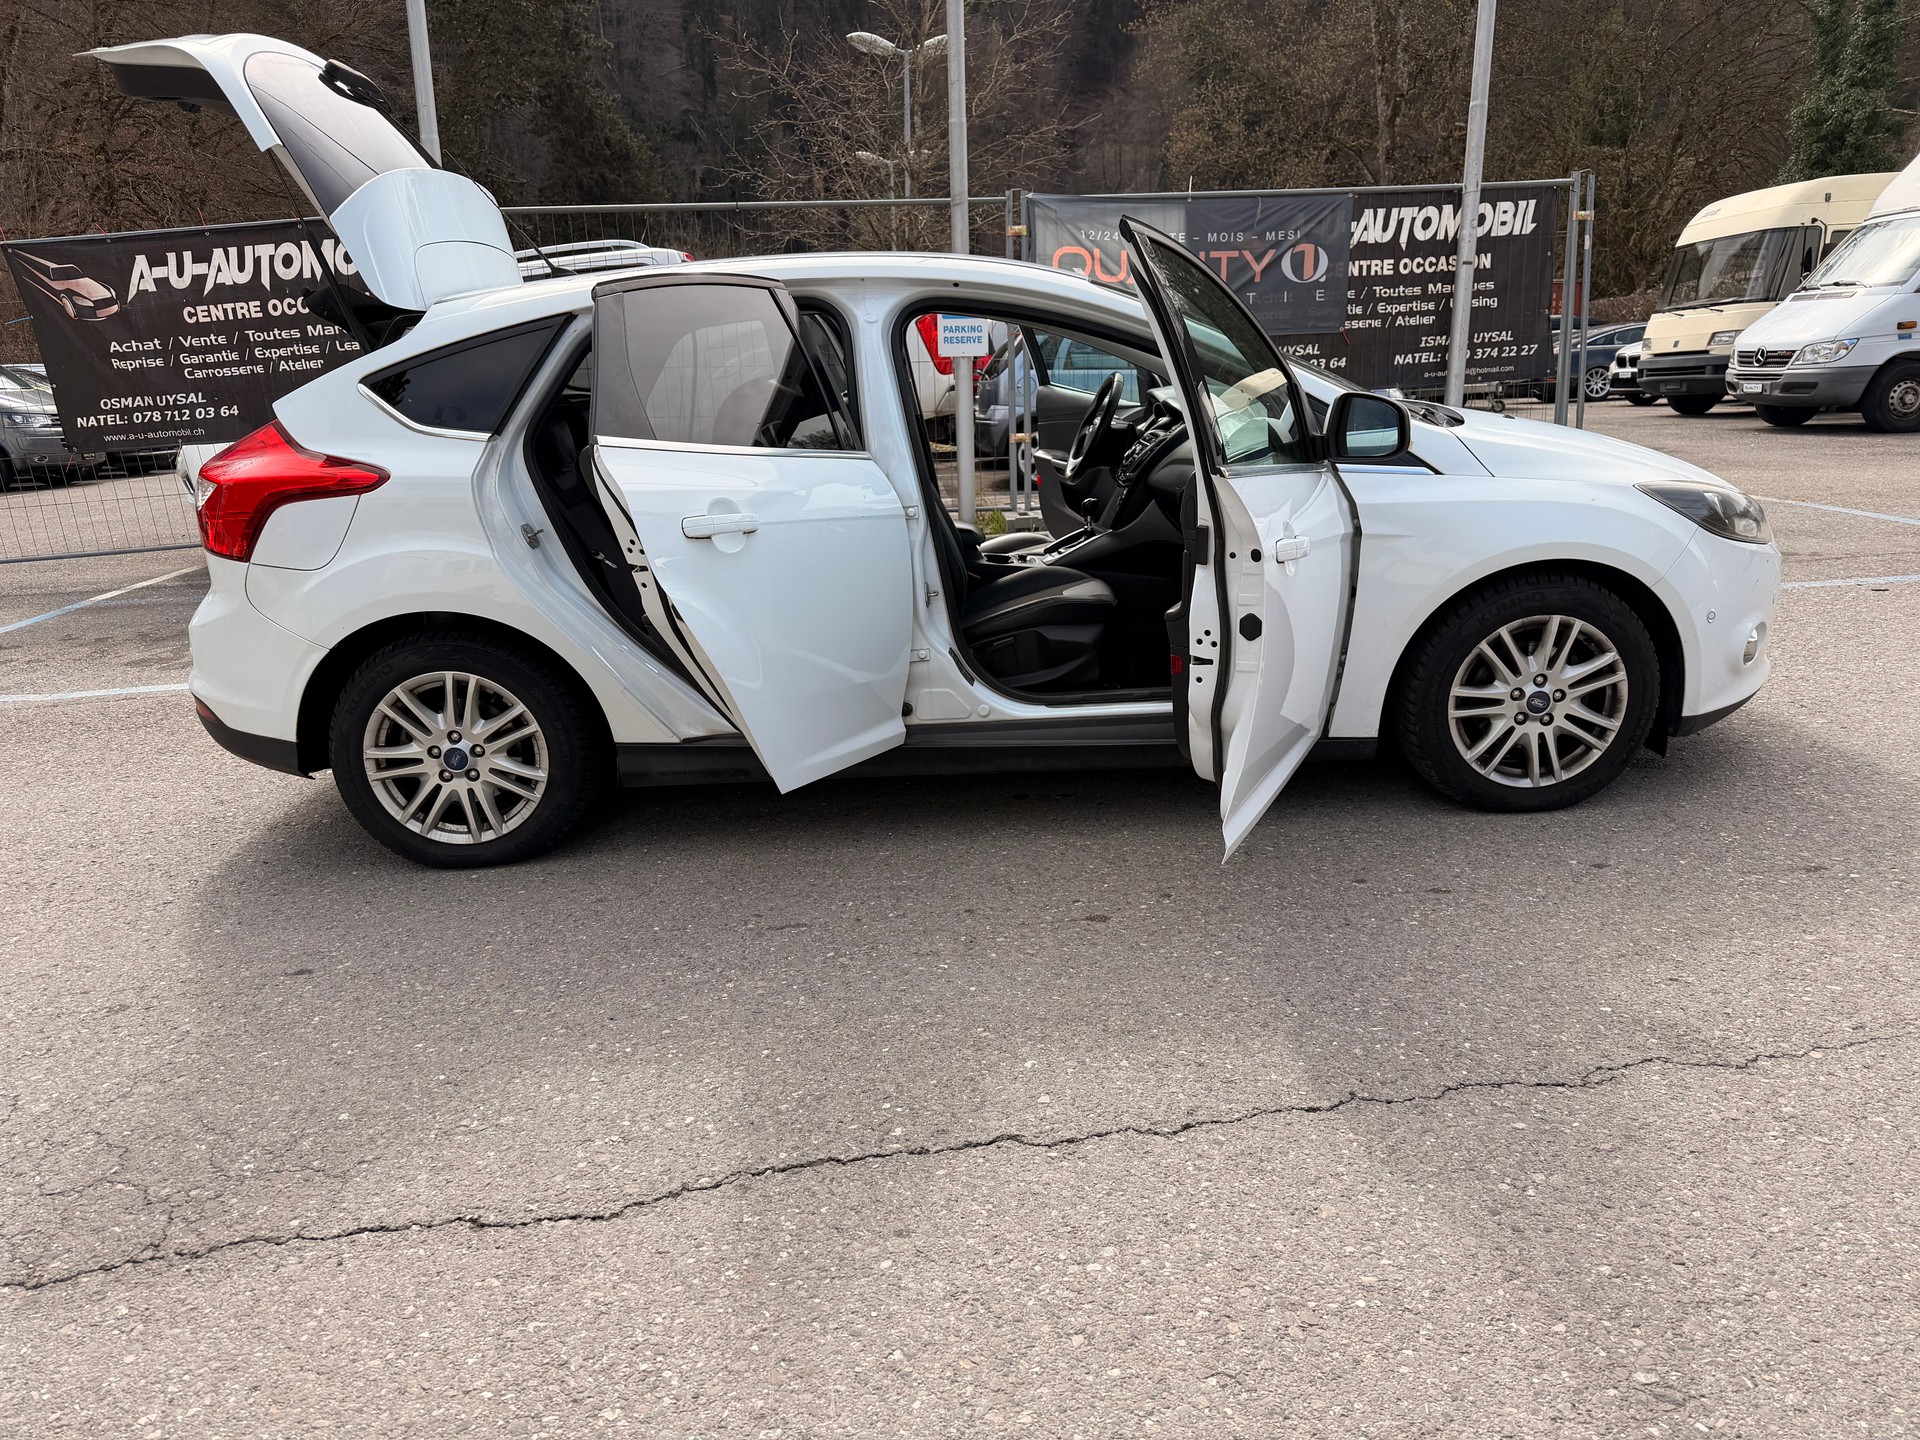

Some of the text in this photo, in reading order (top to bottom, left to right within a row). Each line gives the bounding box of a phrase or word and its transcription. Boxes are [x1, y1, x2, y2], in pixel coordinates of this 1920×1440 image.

[1080, 230, 1119, 241] 12/24
[1207, 232, 1244, 243] MOIS
[1266, 230, 1300, 241] MESI
[127, 239, 357, 303] A-U-AUTOMO
[1399, 252, 1492, 274] OCCASN
[1373, 285, 1422, 298] Toutes
[183, 296, 310, 324] CENTRE OCC
[1377, 300, 1435, 315] Expertise
[943, 325, 983, 334] PARKING
[1344, 319, 1382, 329] sserie
[1395, 314, 1436, 327] Atelier
[110, 338, 162, 353] Achat
[178, 333, 227, 347] Vente
[245, 328, 301, 342] Toutes
[307, 324, 343, 337] Mar
[943, 335, 983, 344] RESERVE
[1473, 331, 1514, 344] UYSAL
[111, 356, 165, 372] Reprise
[179, 349, 240, 365] Garantie
[254, 343, 320, 360] Expertise
[335, 340, 360, 351] Lea
[1329, 356, 1347, 369] 64
[1394, 352, 1442, 366] NATEL:
[1473, 347, 1499, 360] 374
[1501, 345, 1517, 357] 22
[1520, 344, 1538, 356] 27
[184, 364, 265, 379] Carrosserie
[279, 358, 324, 372] Atelier
[100, 392, 207, 410] OSMAN UYSAL
[76, 405, 239, 428] NATEL: 078 712 03 64
[103, 427, 205, 442] www.a-u-automobil.ch
